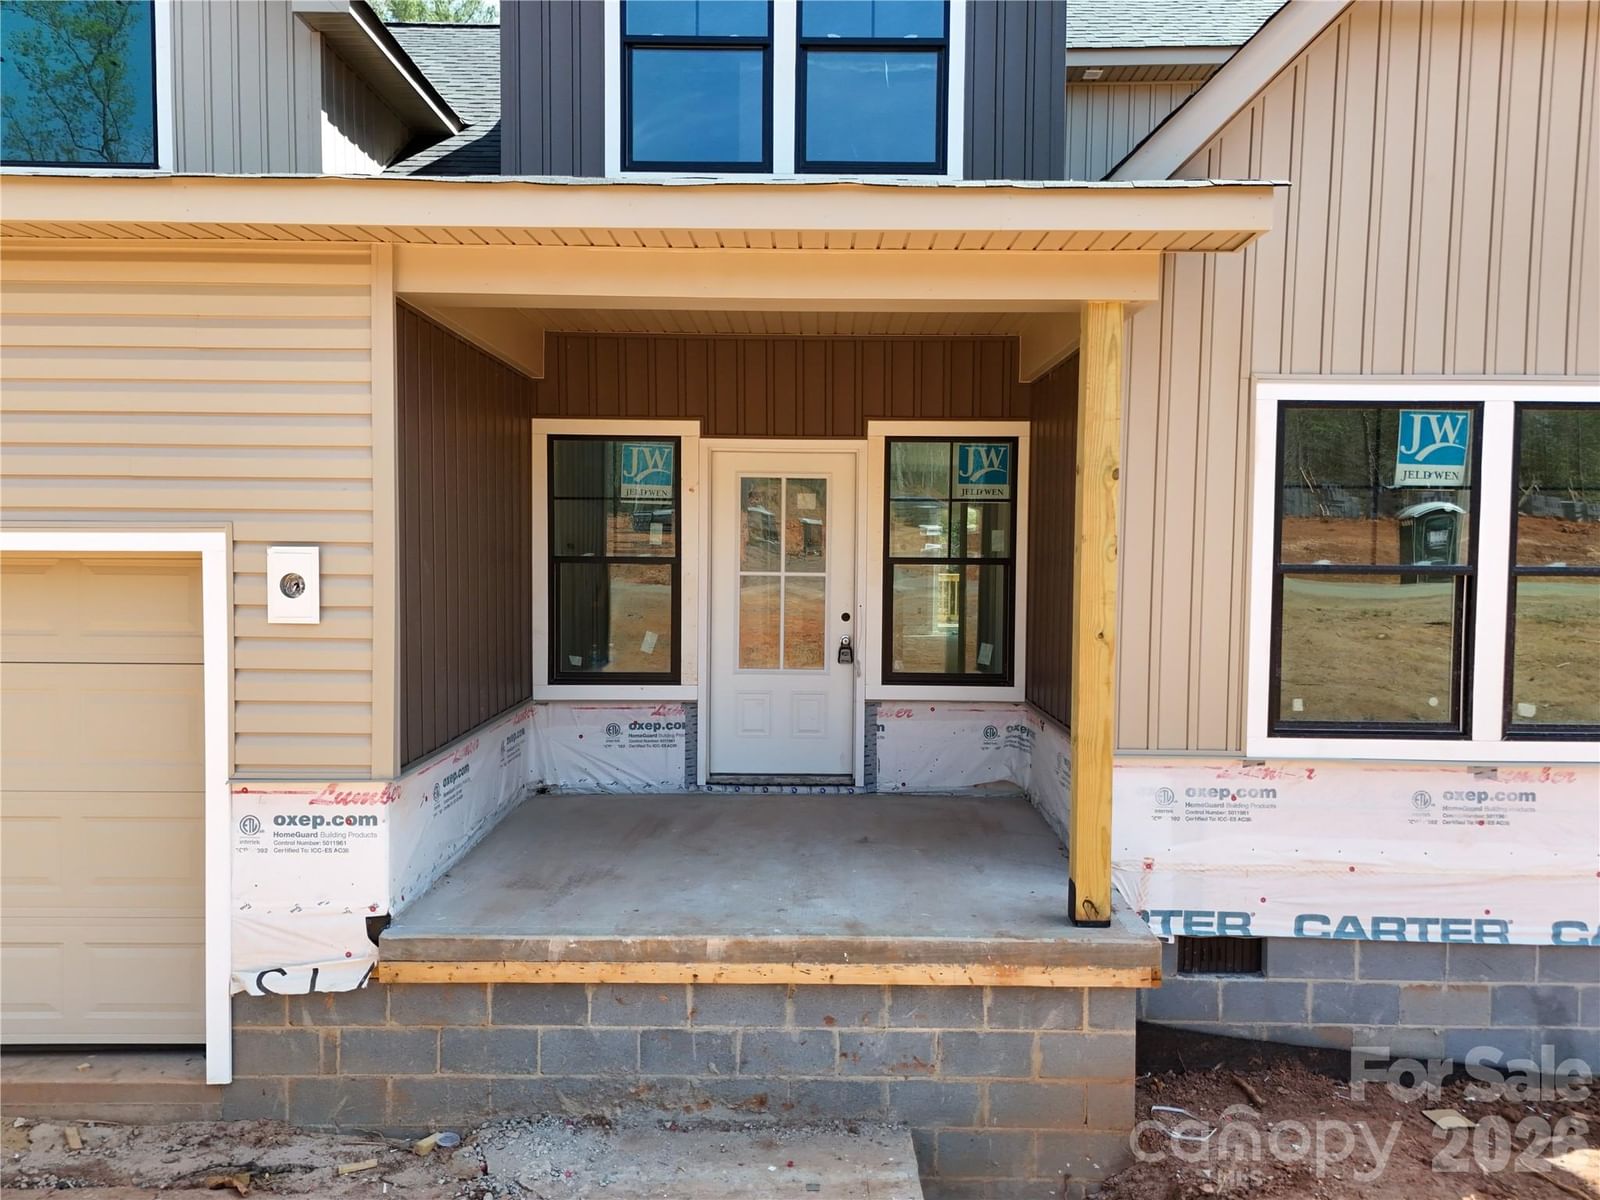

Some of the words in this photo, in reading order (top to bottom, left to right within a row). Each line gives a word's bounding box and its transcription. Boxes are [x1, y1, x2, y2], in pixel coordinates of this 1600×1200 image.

[273, 814, 378, 829] oxep.com
[320, 831, 347, 839] Building
[347, 831, 378, 839] Products
[1294, 913, 1510, 944] CARTER
